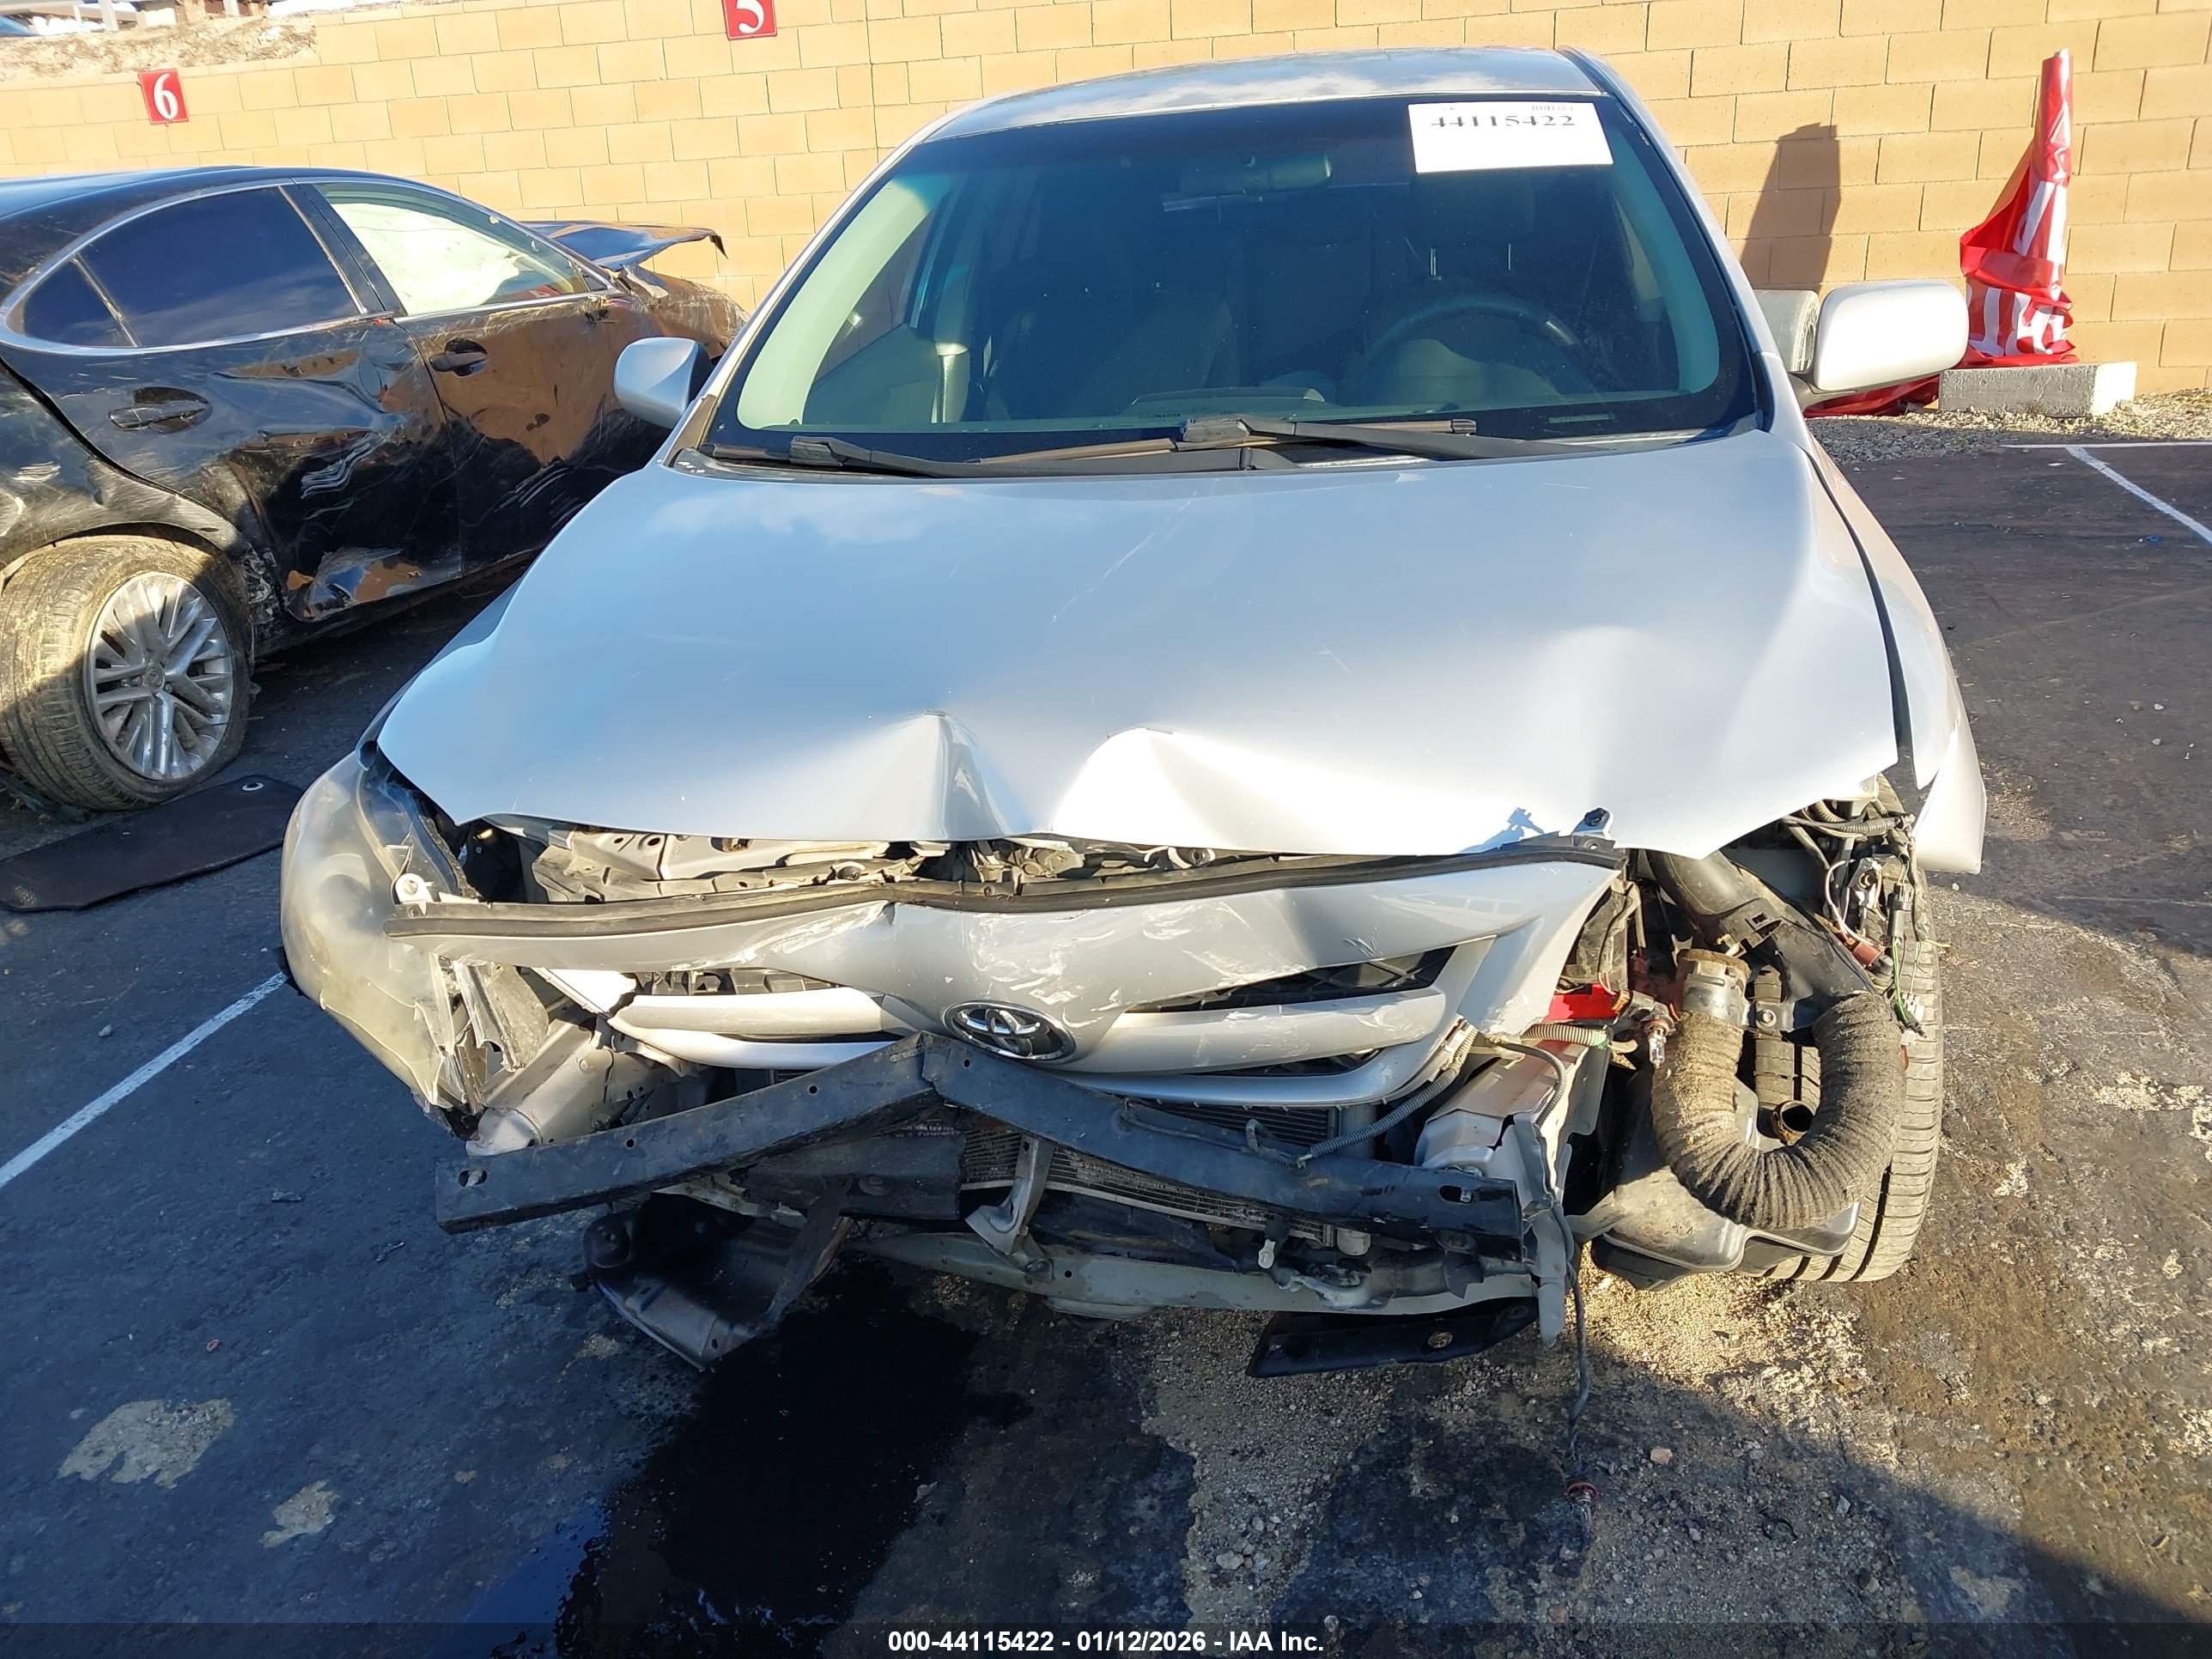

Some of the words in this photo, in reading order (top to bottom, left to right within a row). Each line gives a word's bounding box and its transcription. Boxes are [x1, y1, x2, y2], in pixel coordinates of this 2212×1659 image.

[736, 0, 764, 34] 5
[153, 72, 179, 120] 6
[1431, 114, 1576, 128] 44115422
